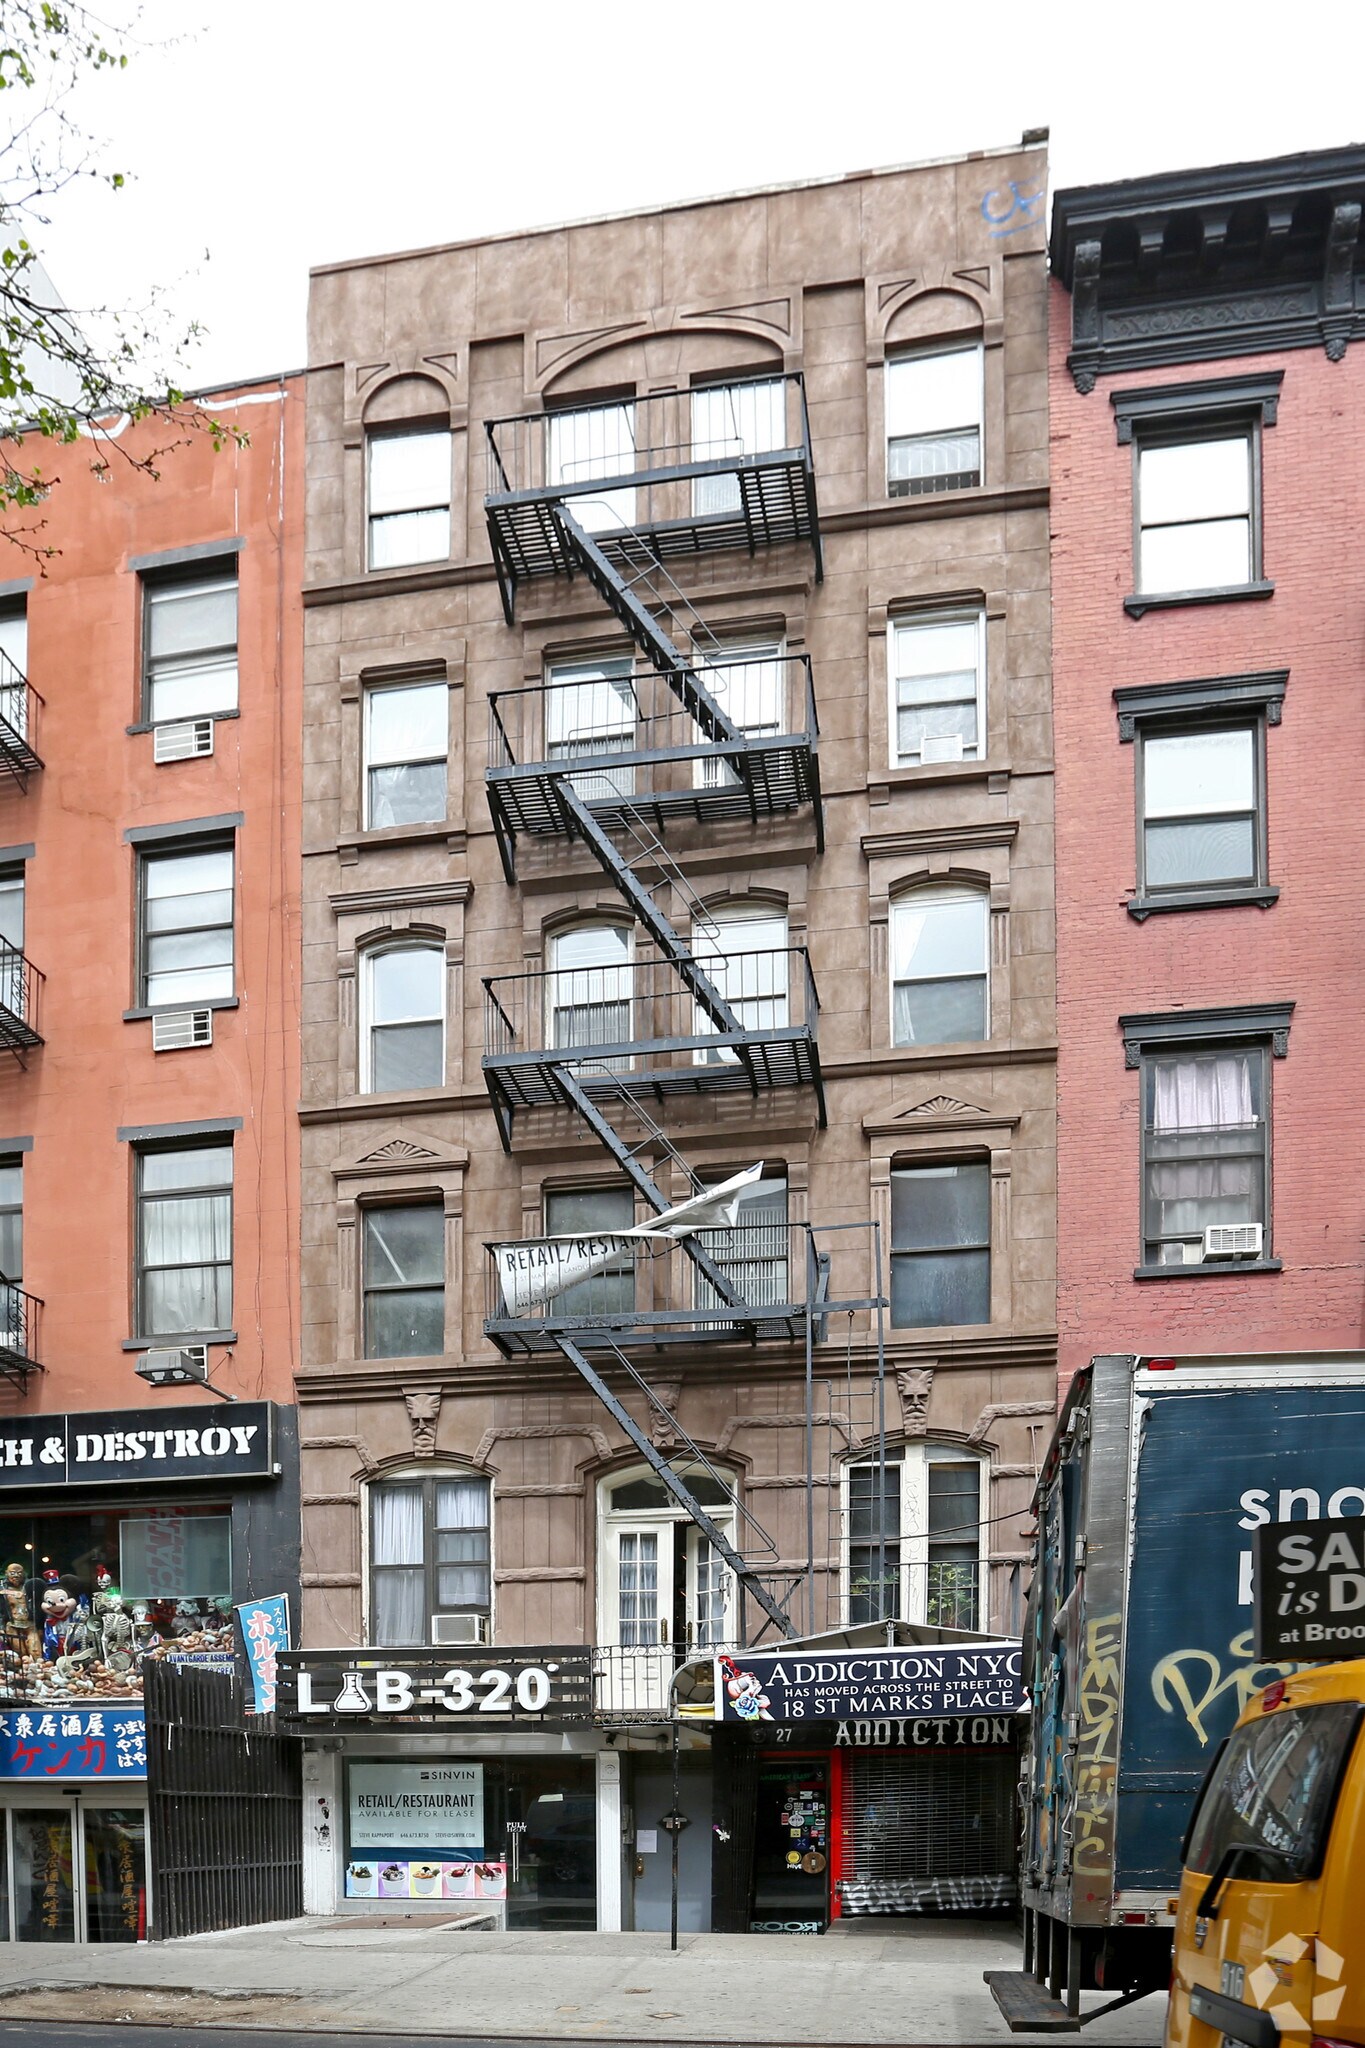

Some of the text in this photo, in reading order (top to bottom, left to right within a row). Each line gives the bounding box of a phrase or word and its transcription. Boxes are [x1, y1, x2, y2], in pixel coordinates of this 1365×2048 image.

[39, 1437, 65, 1464] &
[75, 1426, 258, 1462] DESTROY
[1277, 1531, 1365, 1574] SA
[1277, 1581, 1320, 1616] is
[1279, 1629, 1300, 1643] at
[765, 1658, 945, 1686] ADDICTION
[785, 1678, 1013, 1697] HAS MOVED ACROSS THE STREET TO
[783, 1690, 1013, 1717] 18 ST MARKS PLACE
[776, 1728, 792, 1742] 27
[834, 1717, 1011, 1746] ADDICTION
[10, 1736, 106, 1774] ケンカ
[431, 1771, 475, 1780] SINVIN
[358, 1794, 475, 1809] RETAIL/RESTAURANT
